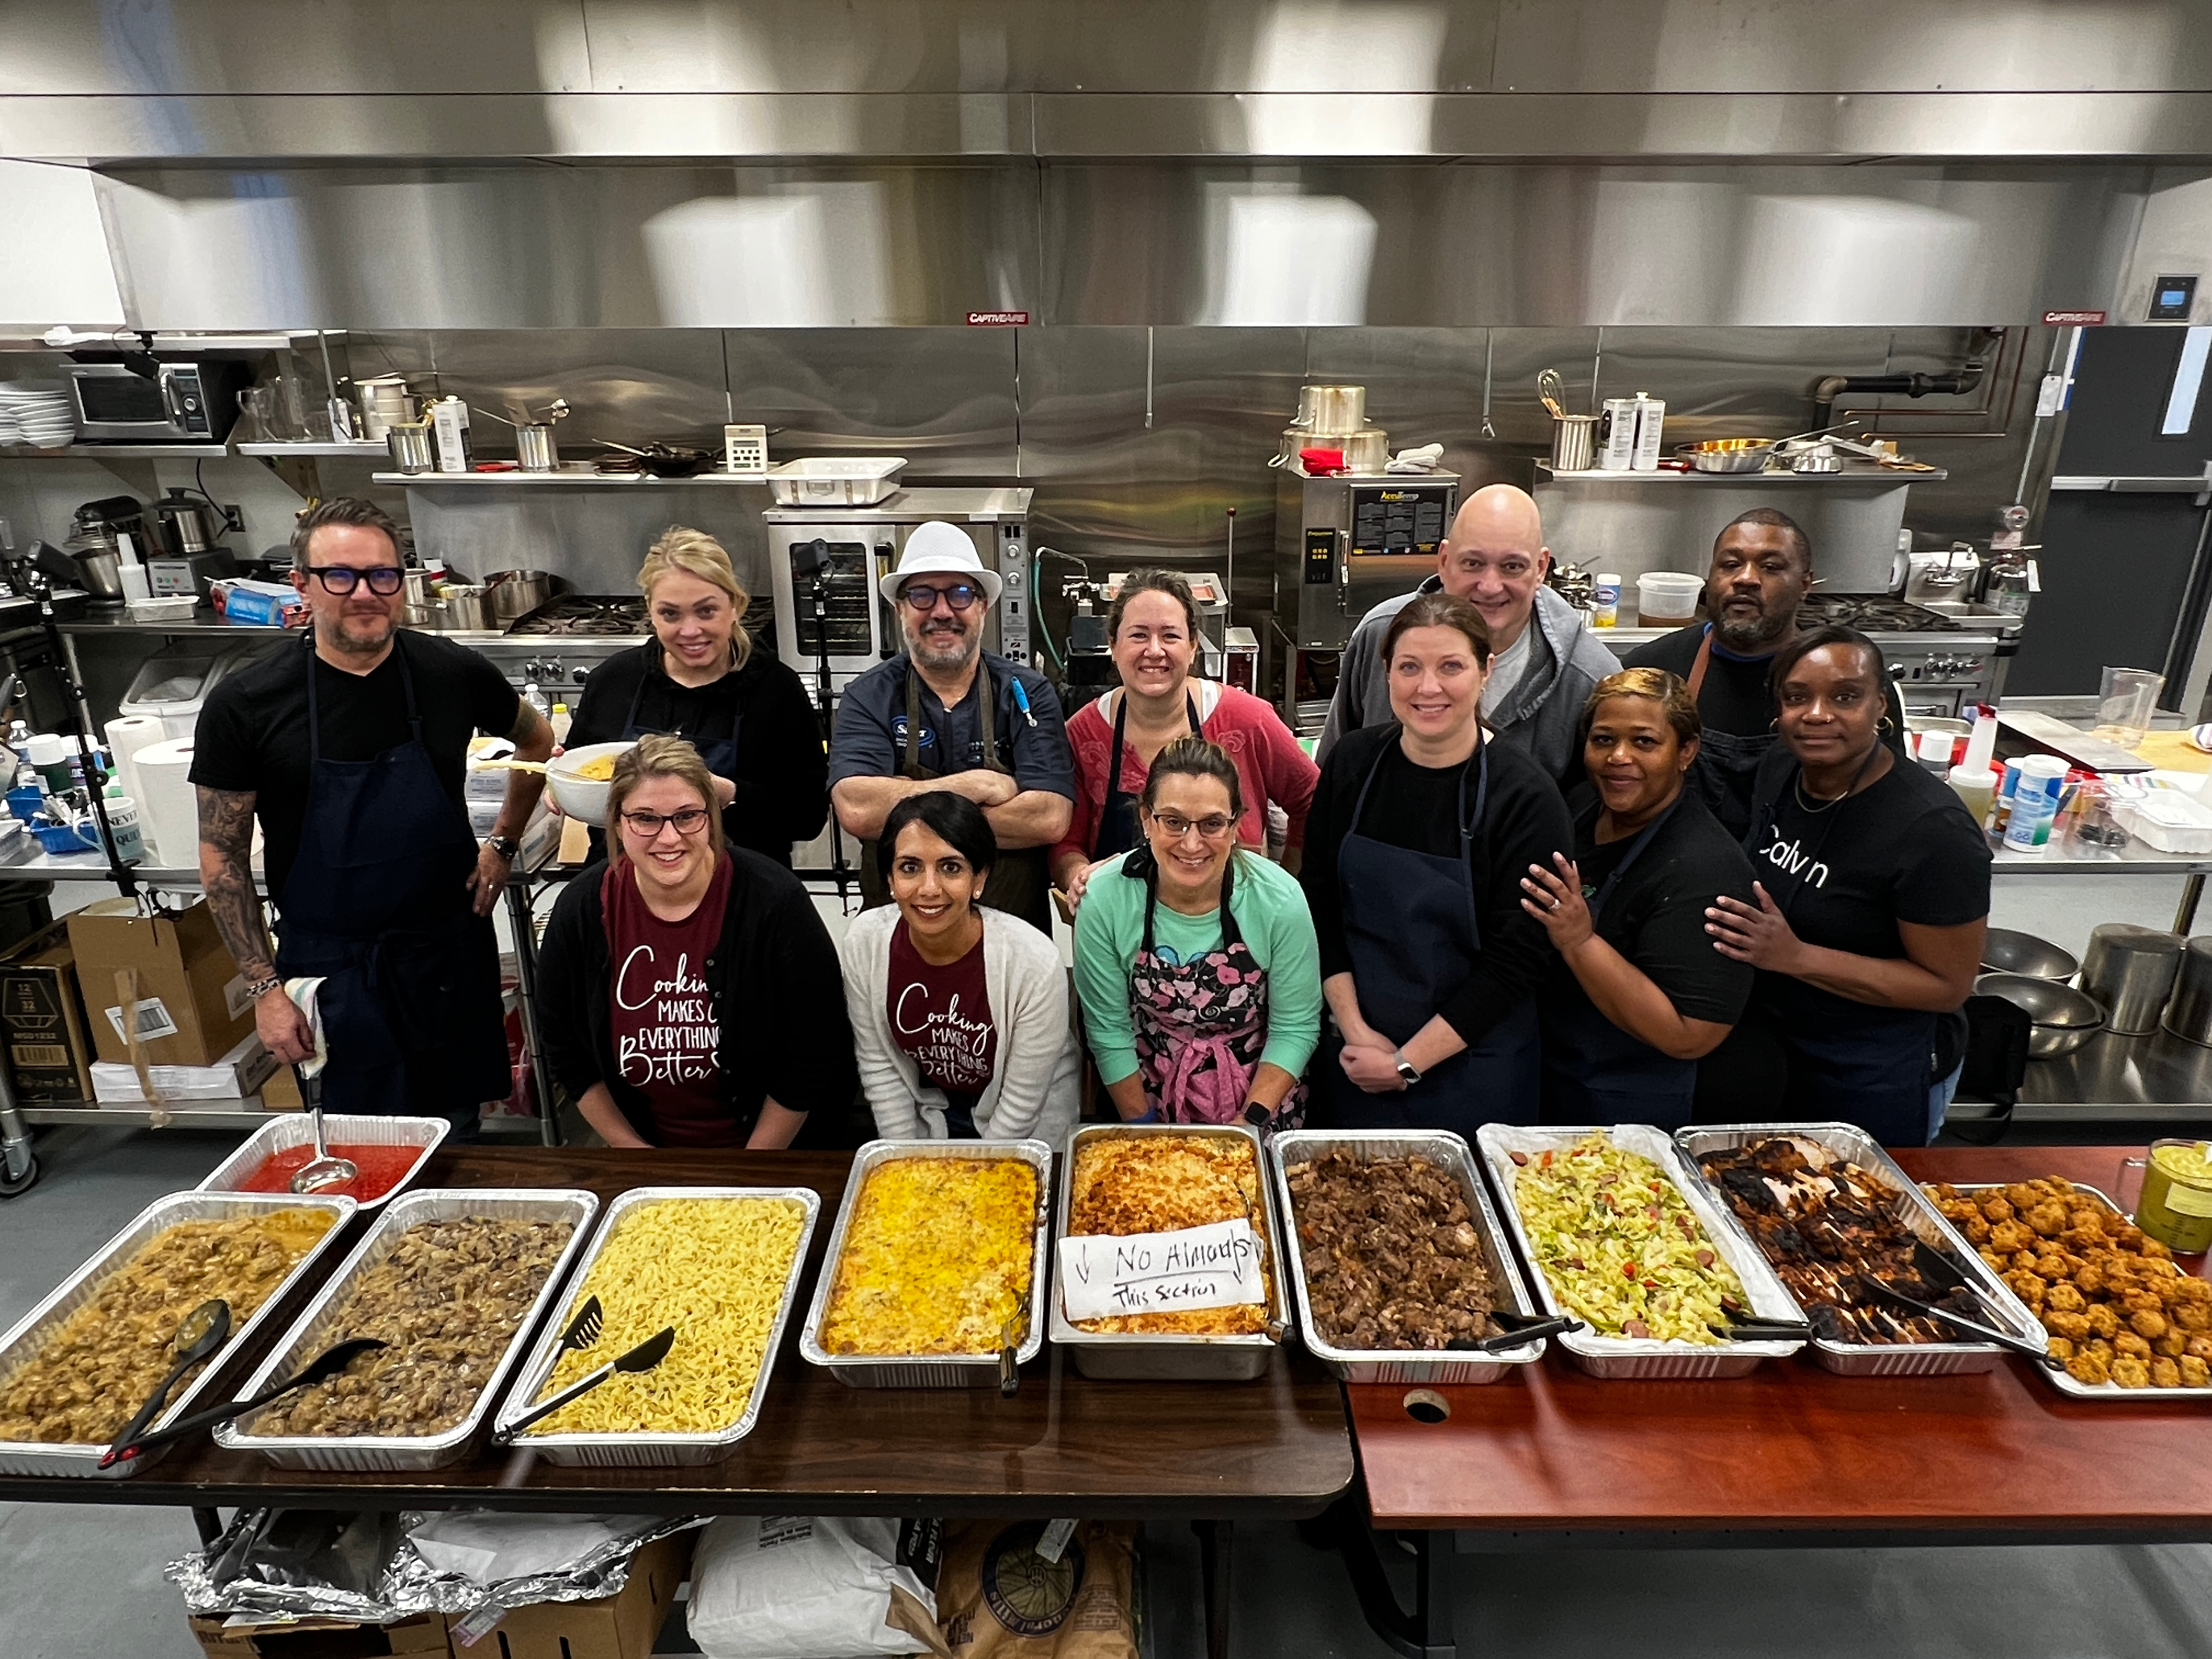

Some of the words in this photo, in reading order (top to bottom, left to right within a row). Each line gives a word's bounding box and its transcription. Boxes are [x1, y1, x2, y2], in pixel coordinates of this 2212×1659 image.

[1759, 824, 1829, 889] alvn
[658, 998, 705, 1023] MAKES
[896, 982, 995, 1057] Cooking
[639, 1026, 720, 1050] EVERYTHIN
[932, 1027, 969, 1052] MAKES
[618, 1035, 712, 1087] Better
[917, 1045, 988, 1071] EVERYTHING
[1113, 1284, 1149, 1308] This
